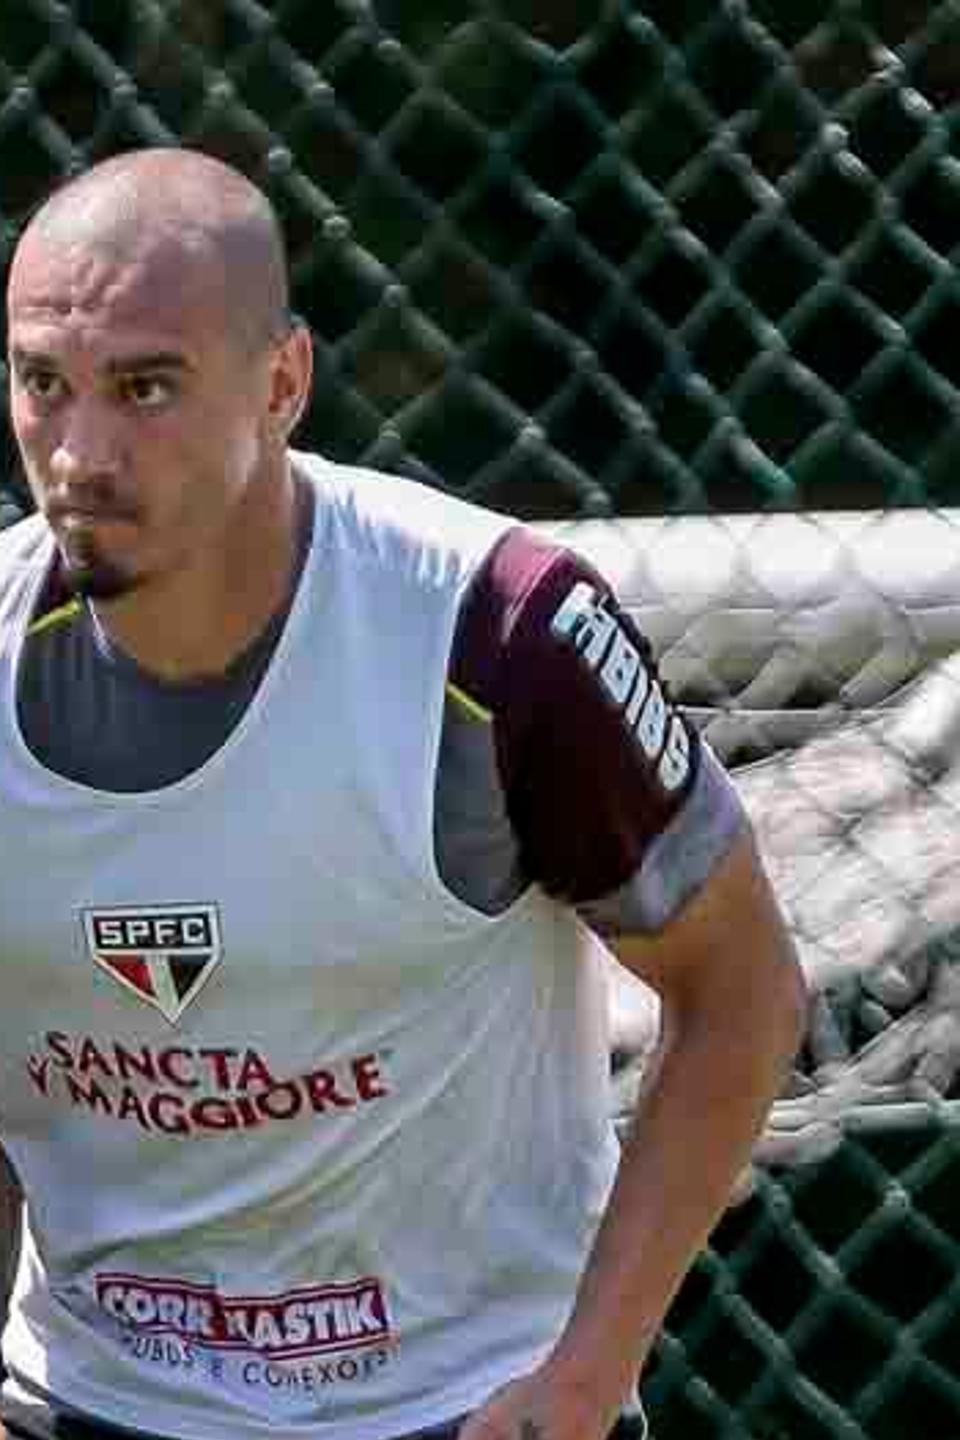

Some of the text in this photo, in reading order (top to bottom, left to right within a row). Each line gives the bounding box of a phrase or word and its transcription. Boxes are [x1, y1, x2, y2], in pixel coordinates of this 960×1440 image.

[98, 918, 206, 945] SPFC
[46, 1029, 271, 1091] SANCTA
[68, 1053, 388, 1135] MAGGIORE
